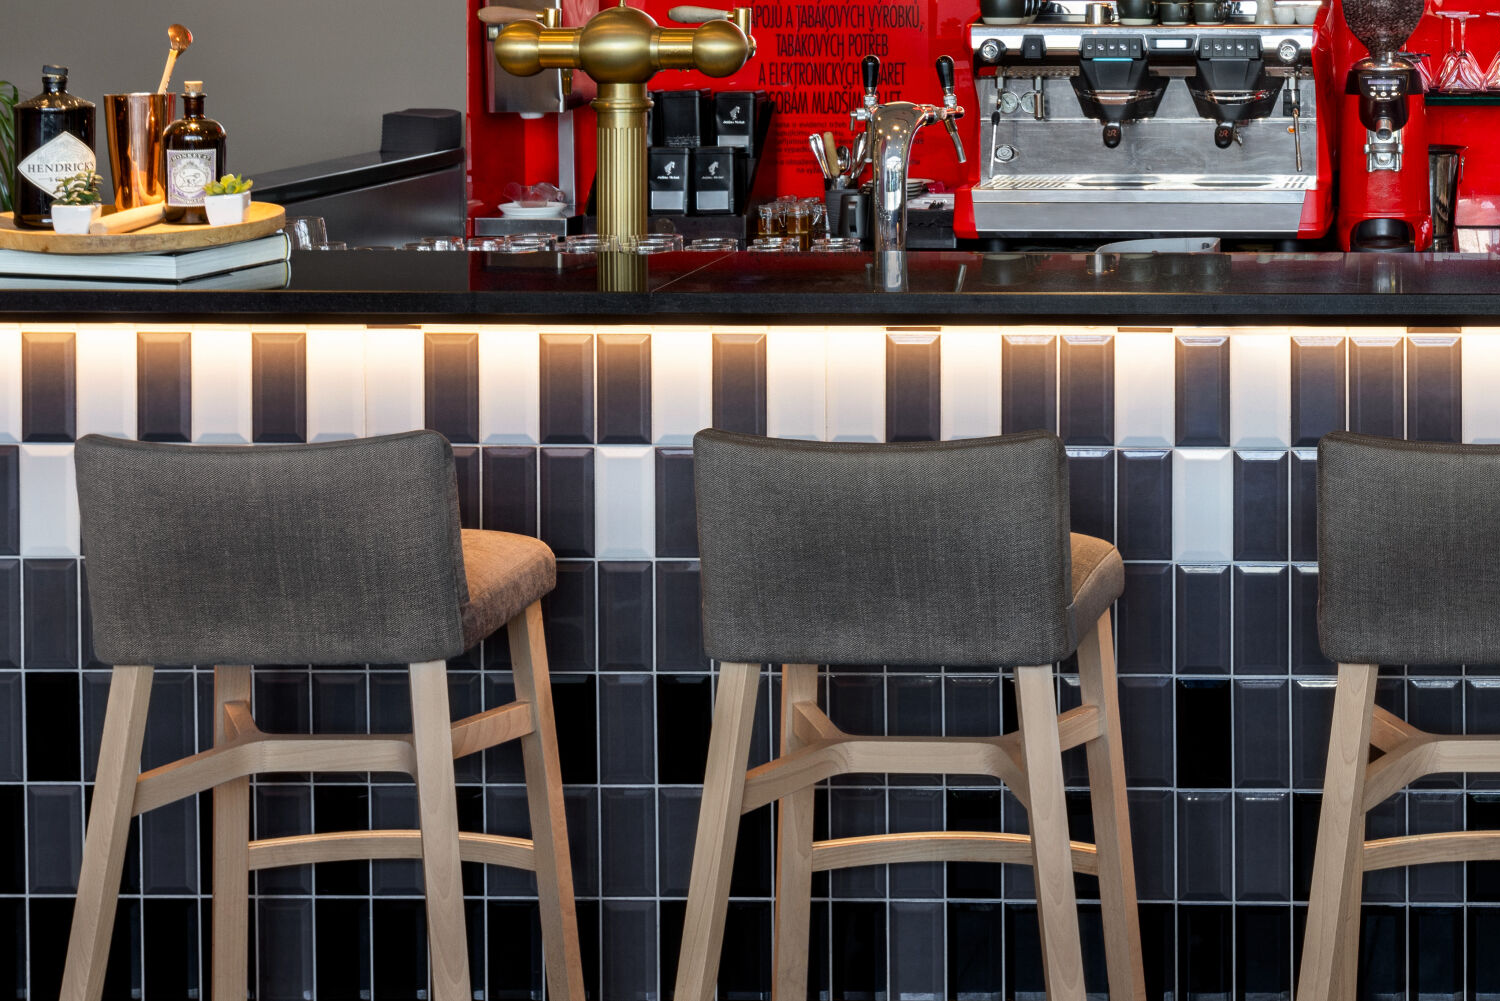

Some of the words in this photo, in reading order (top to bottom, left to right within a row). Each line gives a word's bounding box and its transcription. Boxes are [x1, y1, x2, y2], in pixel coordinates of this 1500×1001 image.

[751, 1, 783, 28] ÁPOJŮ
[785, 5, 794, 28] A
[797, 1, 865, 29] TABÁKOVÝCH
[776, 30, 845, 57] TABÁKOVÝCH
[848, 28, 889, 57] POTŘEB
[758, 62, 766, 86] A
[769, 58, 860, 86] ELEKTRONICKÝCH
[767, 87, 809, 114] SOBÁM
